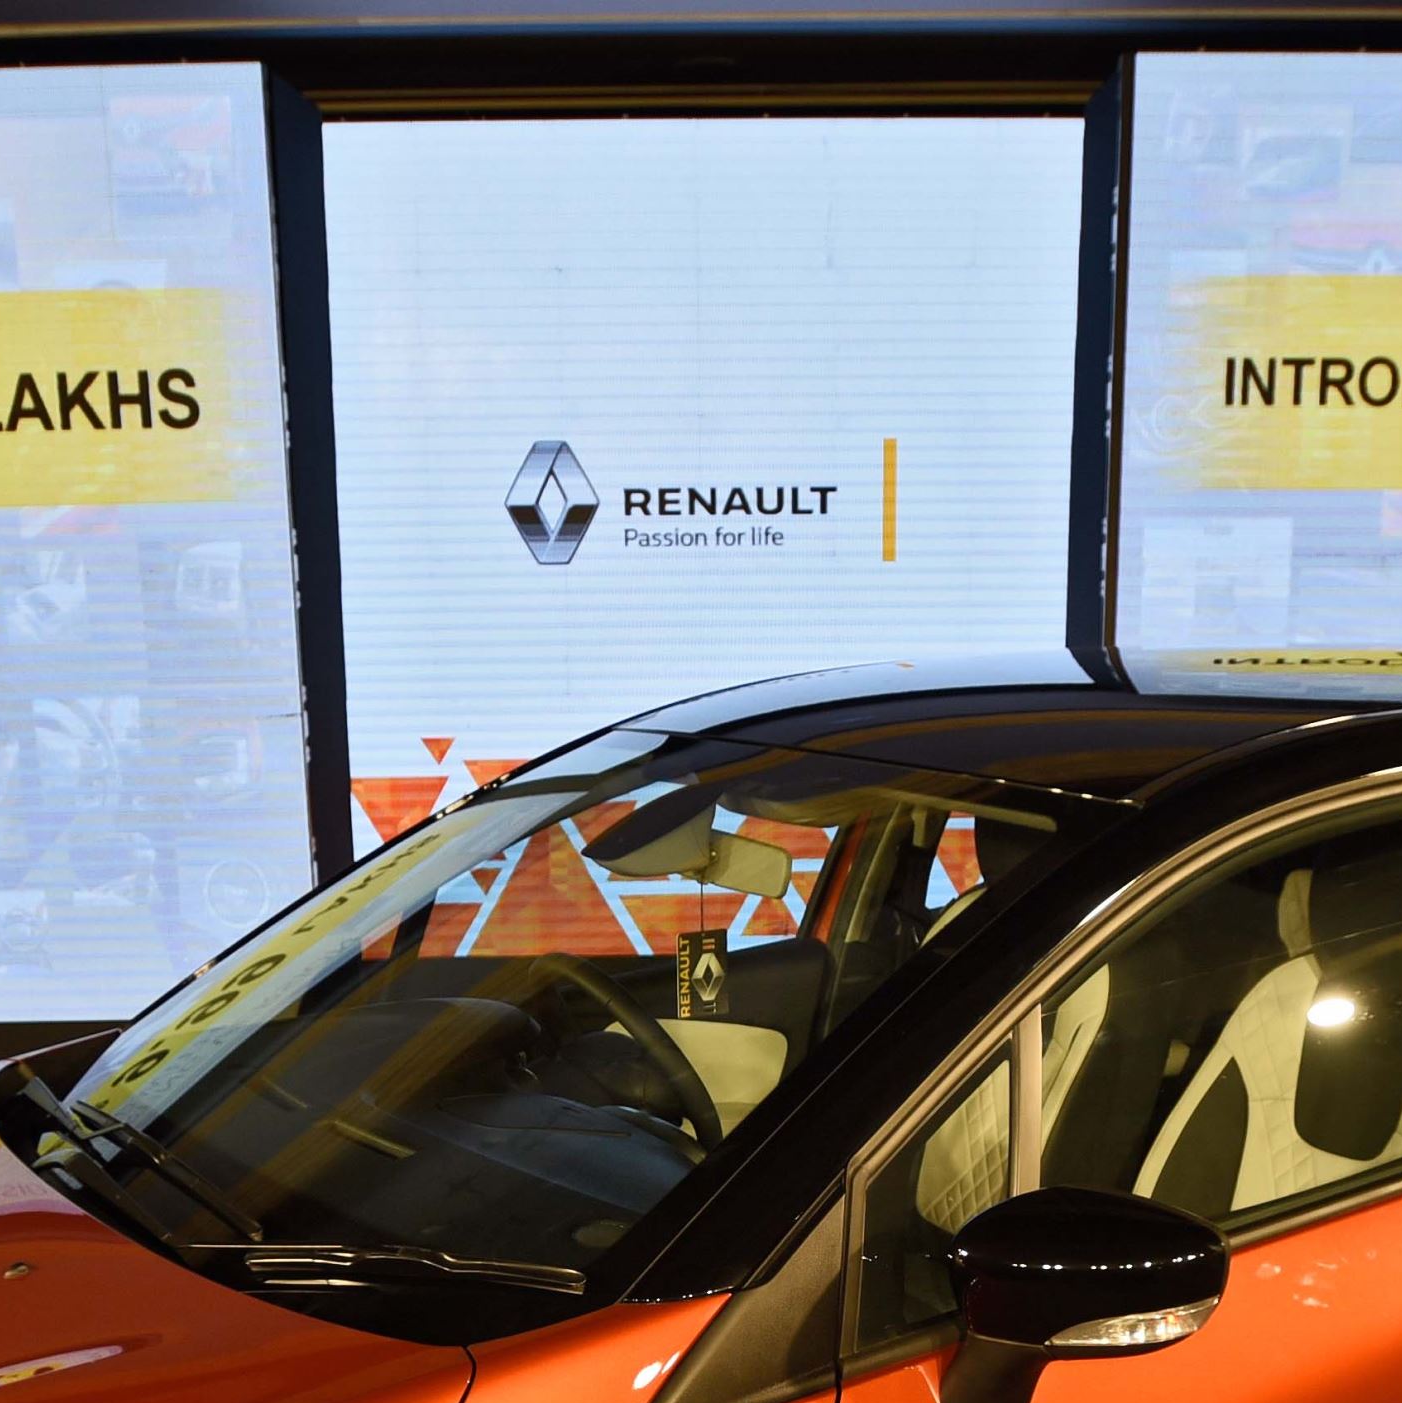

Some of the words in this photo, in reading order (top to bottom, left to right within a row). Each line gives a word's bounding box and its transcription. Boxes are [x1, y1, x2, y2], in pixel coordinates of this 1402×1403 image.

[624, 486, 838, 516] RENAULT
[624, 528, 708, 548] Passion
[714, 527, 746, 547] for
[751, 526, 785, 547] life
[680, 936, 692, 1018] RENAULT
